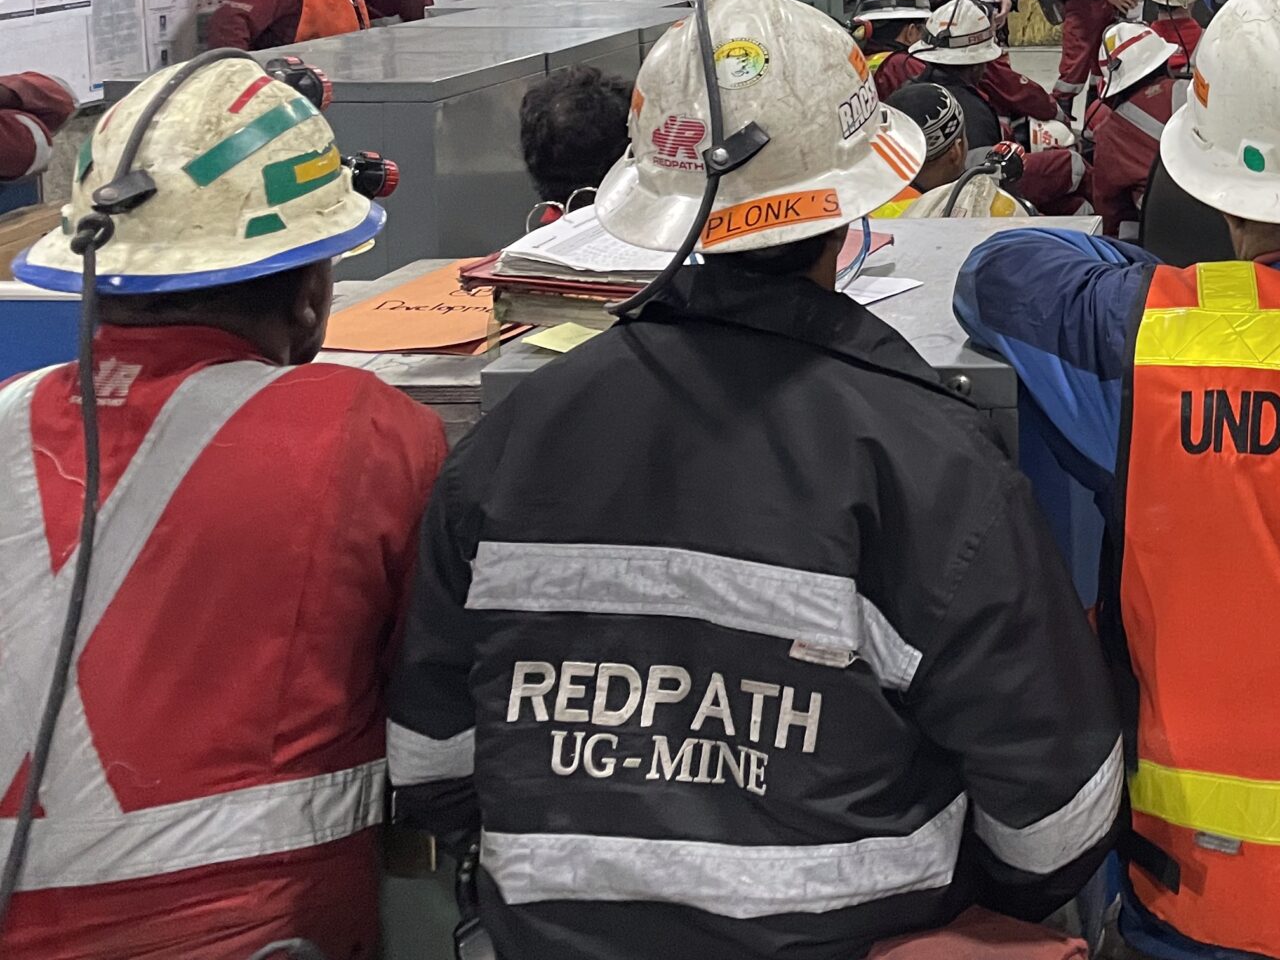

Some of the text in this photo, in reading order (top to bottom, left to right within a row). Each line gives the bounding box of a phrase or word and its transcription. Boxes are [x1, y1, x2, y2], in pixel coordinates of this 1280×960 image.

[652, 156, 704, 171] REDPATH
[706, 193, 840, 240] PLONK'S
[506, 661, 822, 754] REDPATH
[550, 730, 768, 797] UG-MINE
